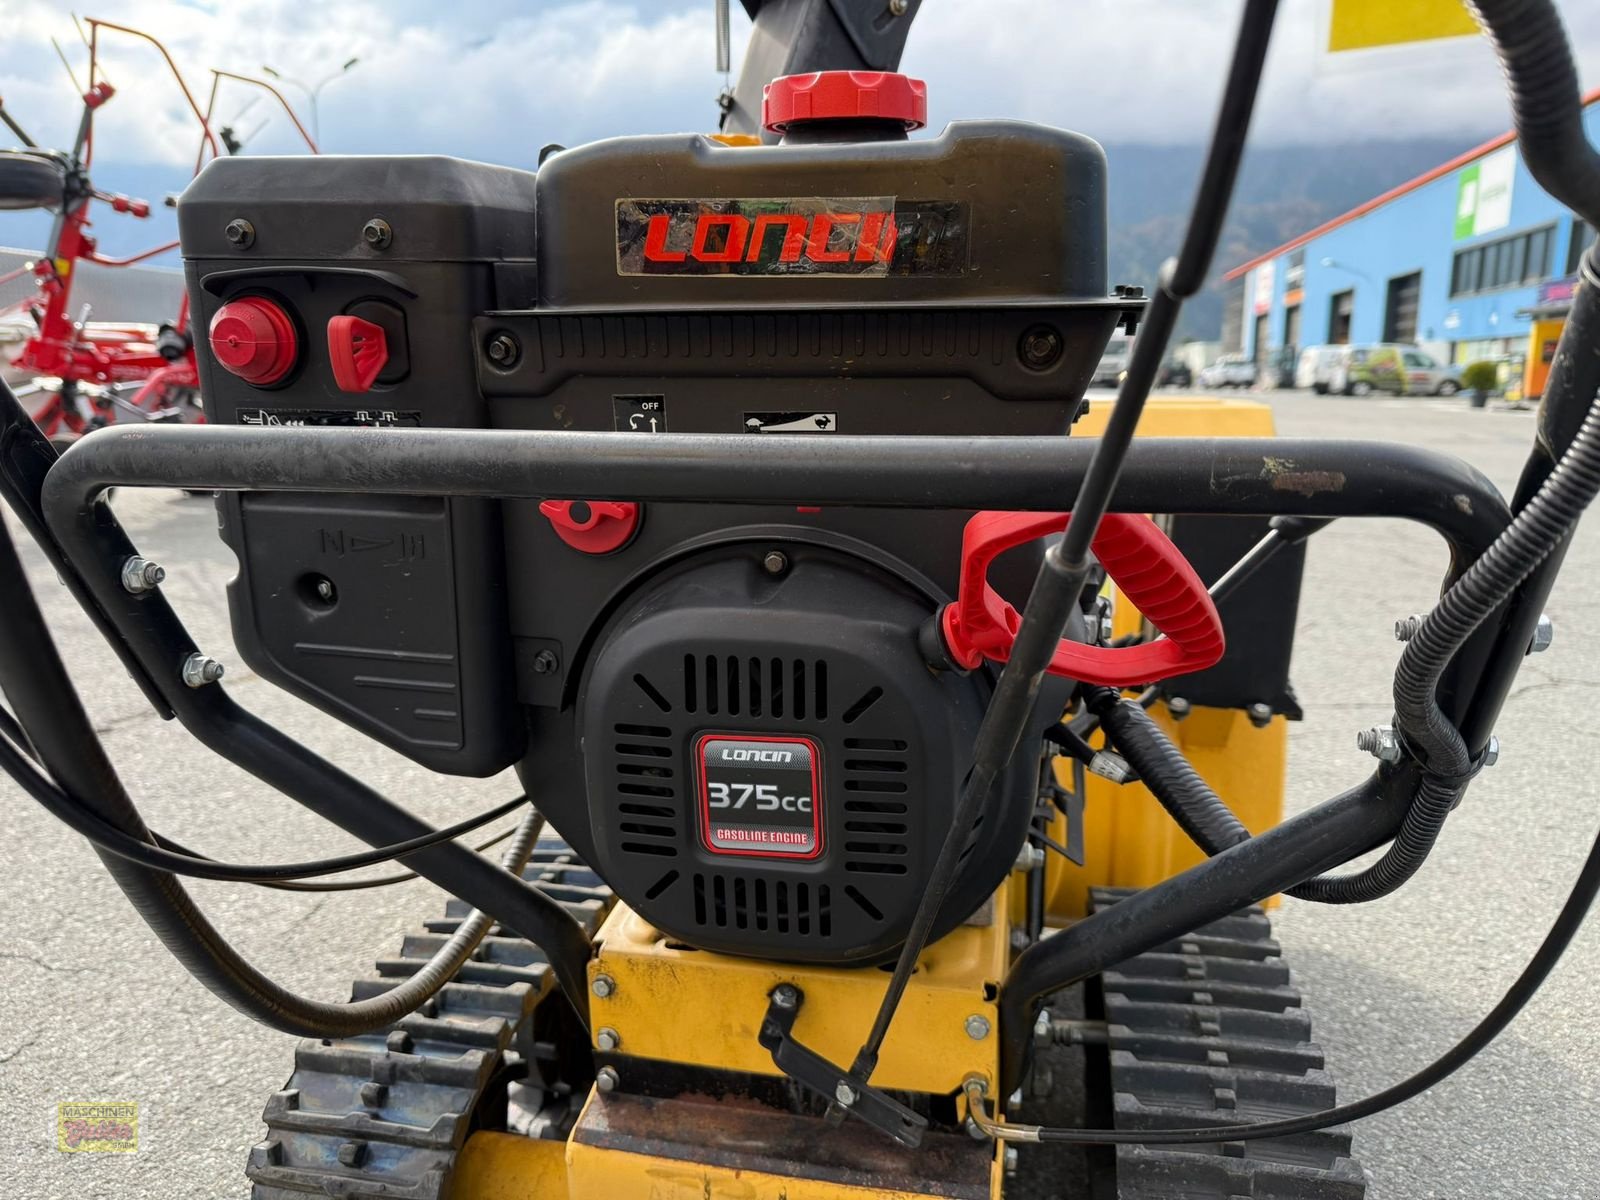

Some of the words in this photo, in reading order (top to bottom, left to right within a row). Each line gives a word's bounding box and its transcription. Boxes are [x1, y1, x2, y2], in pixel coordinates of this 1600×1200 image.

[642, 402, 659, 410] OFF
[721, 748, 792, 763] LONCIN
[707, 782, 812, 812] 375cc
[717, 829, 767, 842] GASOLINE
[770, 832, 808, 844] ENGINE
